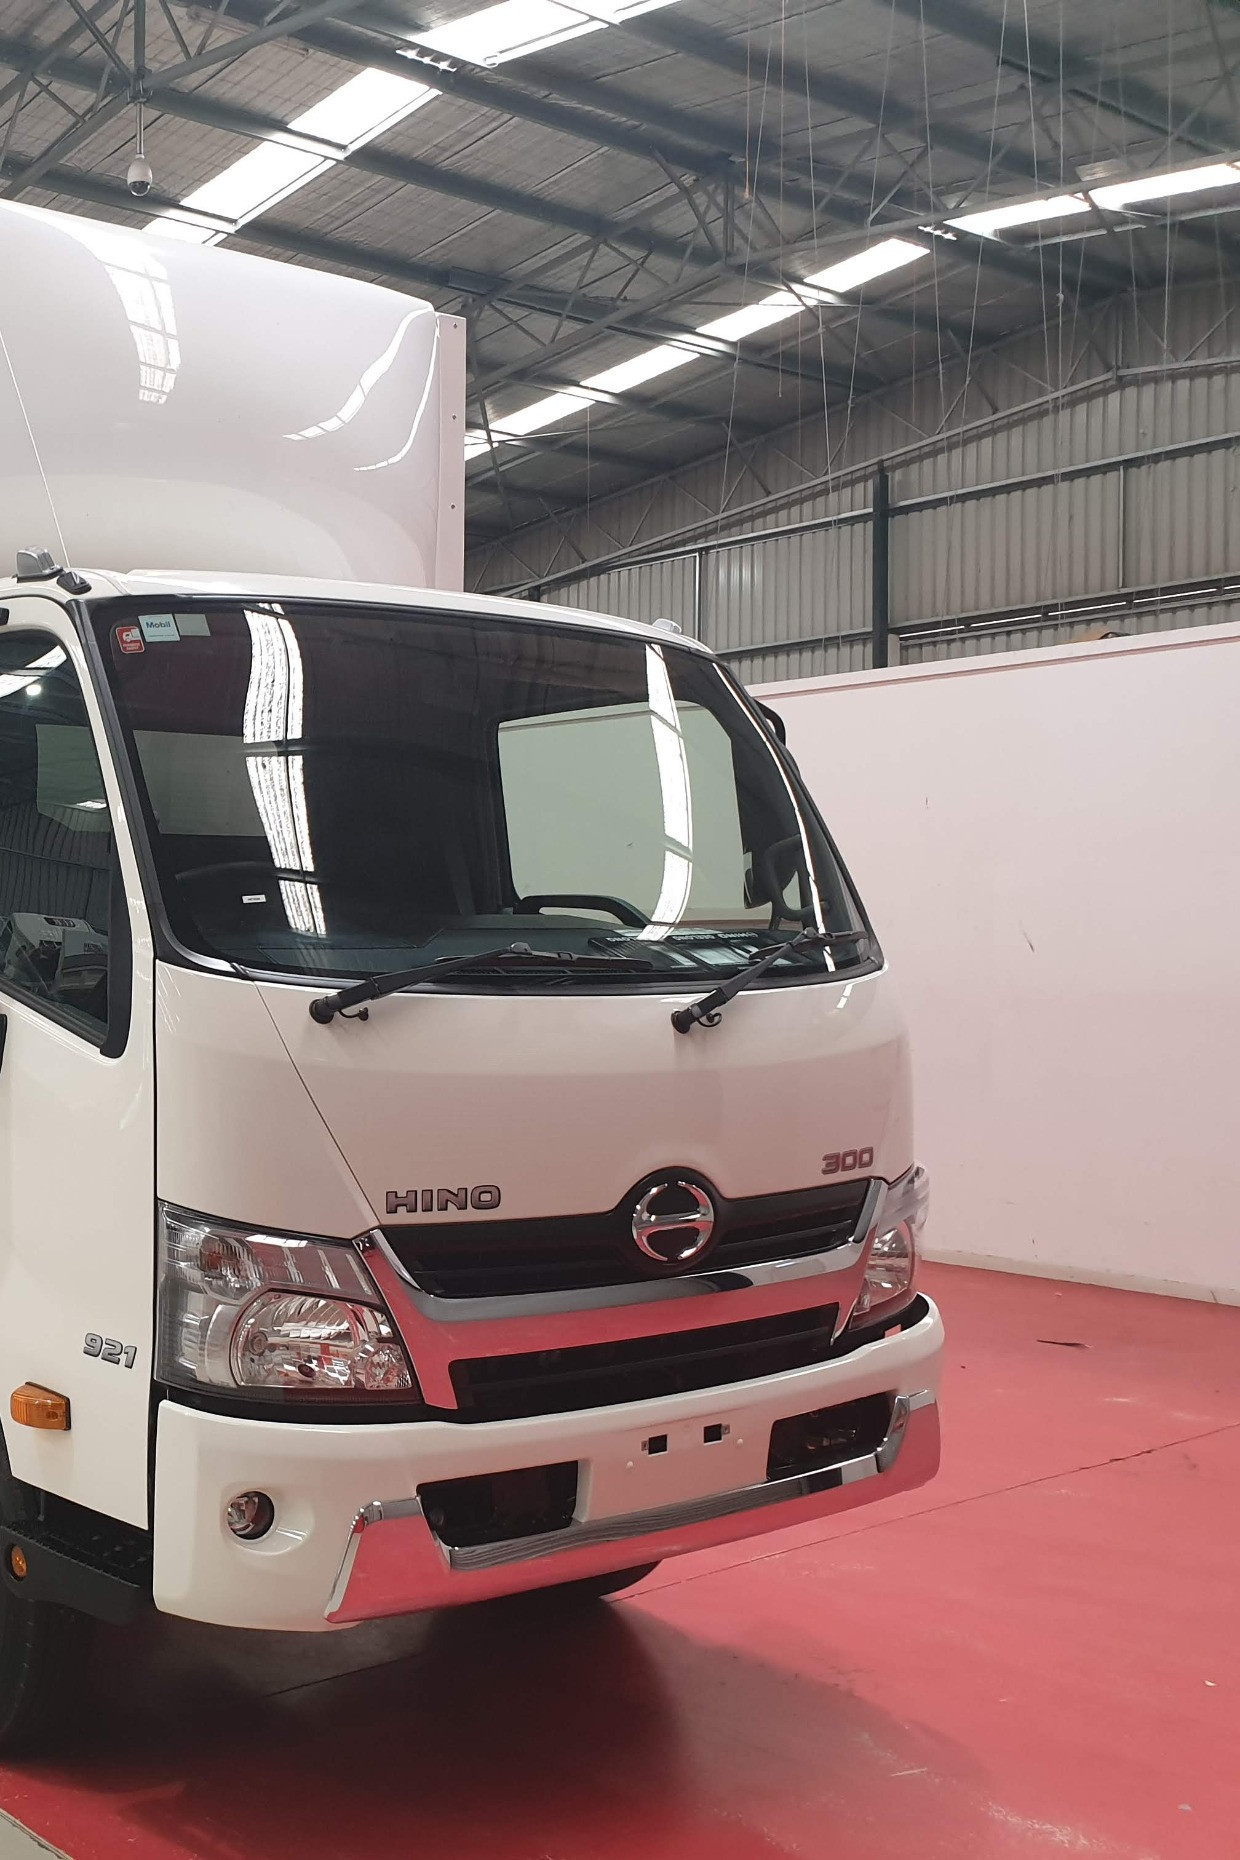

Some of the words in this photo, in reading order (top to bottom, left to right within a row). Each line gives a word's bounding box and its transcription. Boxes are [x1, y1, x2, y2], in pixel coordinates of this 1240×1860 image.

[821, 1146, 874, 1175] 300
[385, 1184, 502, 1214] HINO
[82, 1332, 138, 1369] 921
